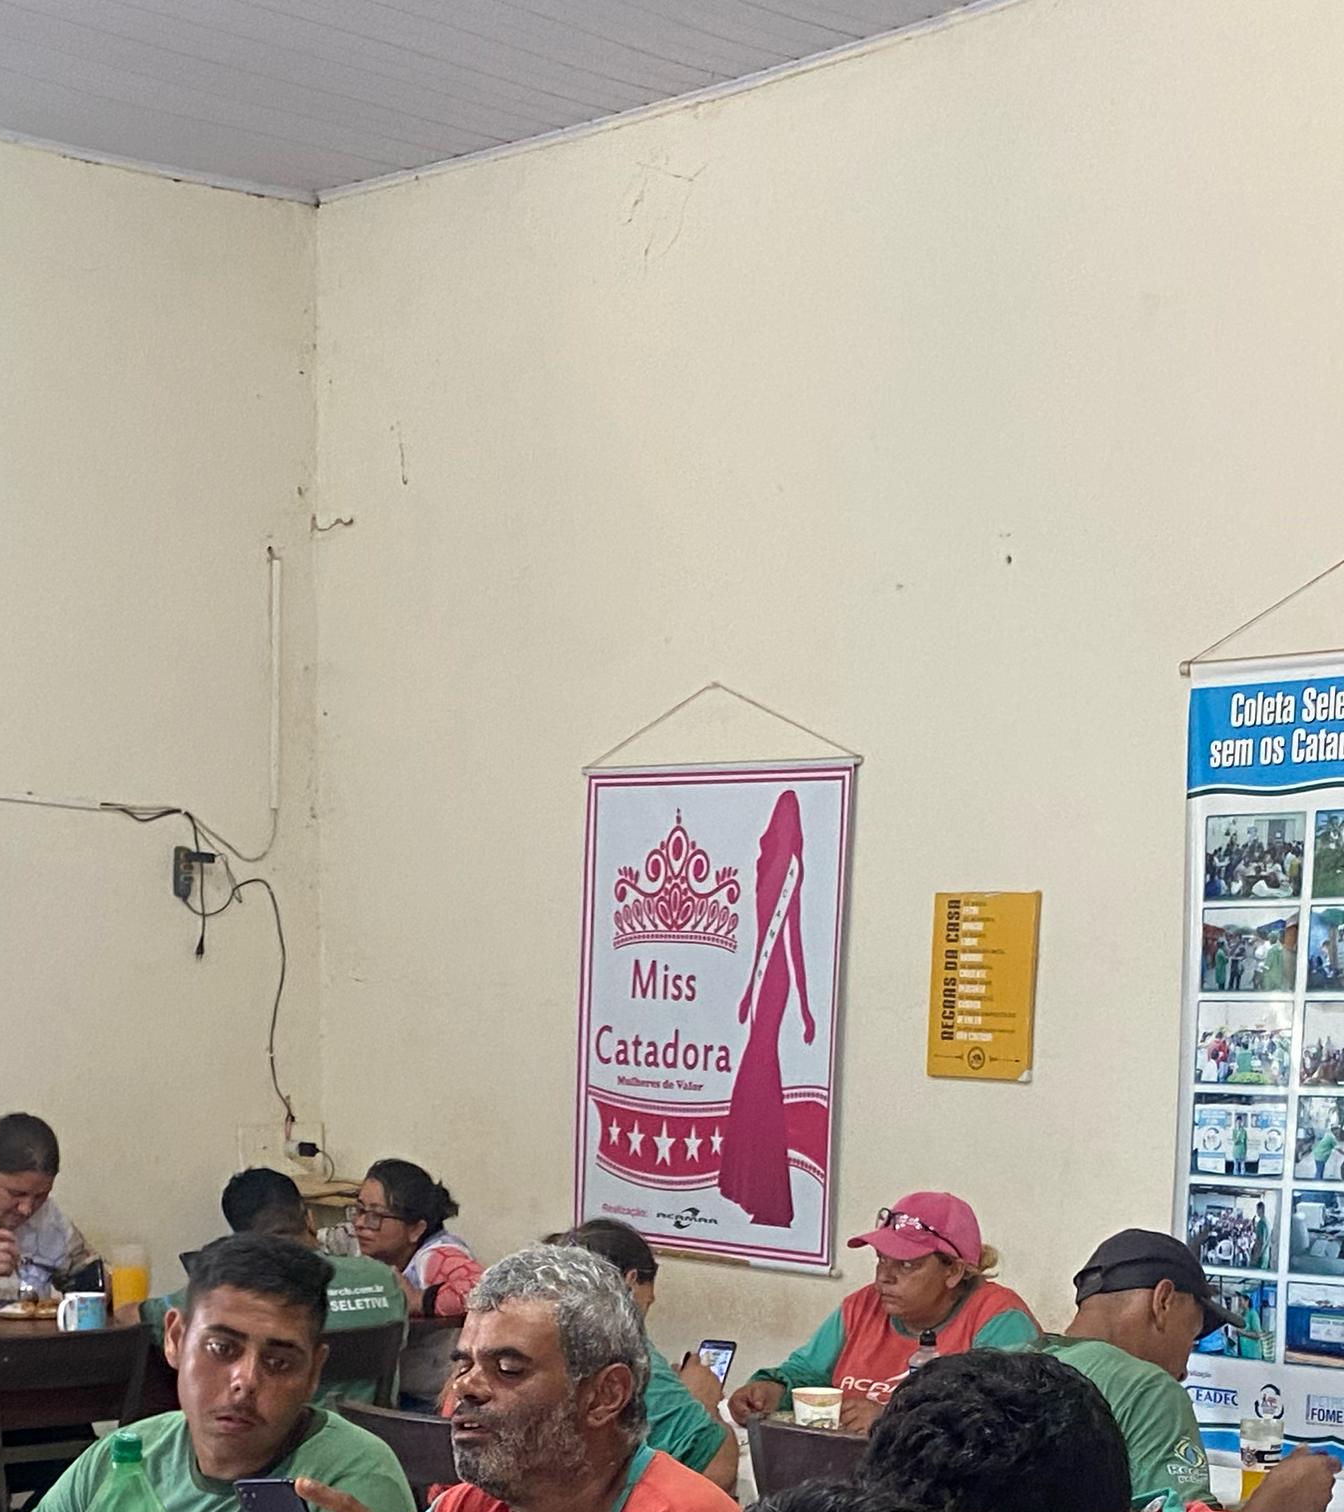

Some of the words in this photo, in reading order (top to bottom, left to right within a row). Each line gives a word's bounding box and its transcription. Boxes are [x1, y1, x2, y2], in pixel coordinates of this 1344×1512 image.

[1230, 690, 1295, 729] Coleta
[1210, 736, 1253, 769] sem
[1259, 734, 1284, 766] os
[631, 959, 697, 1002] Miss
[595, 1024, 732, 1073] Catadora
[617, 1076, 661, 1089] Mulheres
[661, 1080, 675, 1090] de
[676, 1080, 704, 1091] Valor
[329, 1297, 389, 1312] SELETIVA
[1311, 1407, 1343, 1424] FOME
